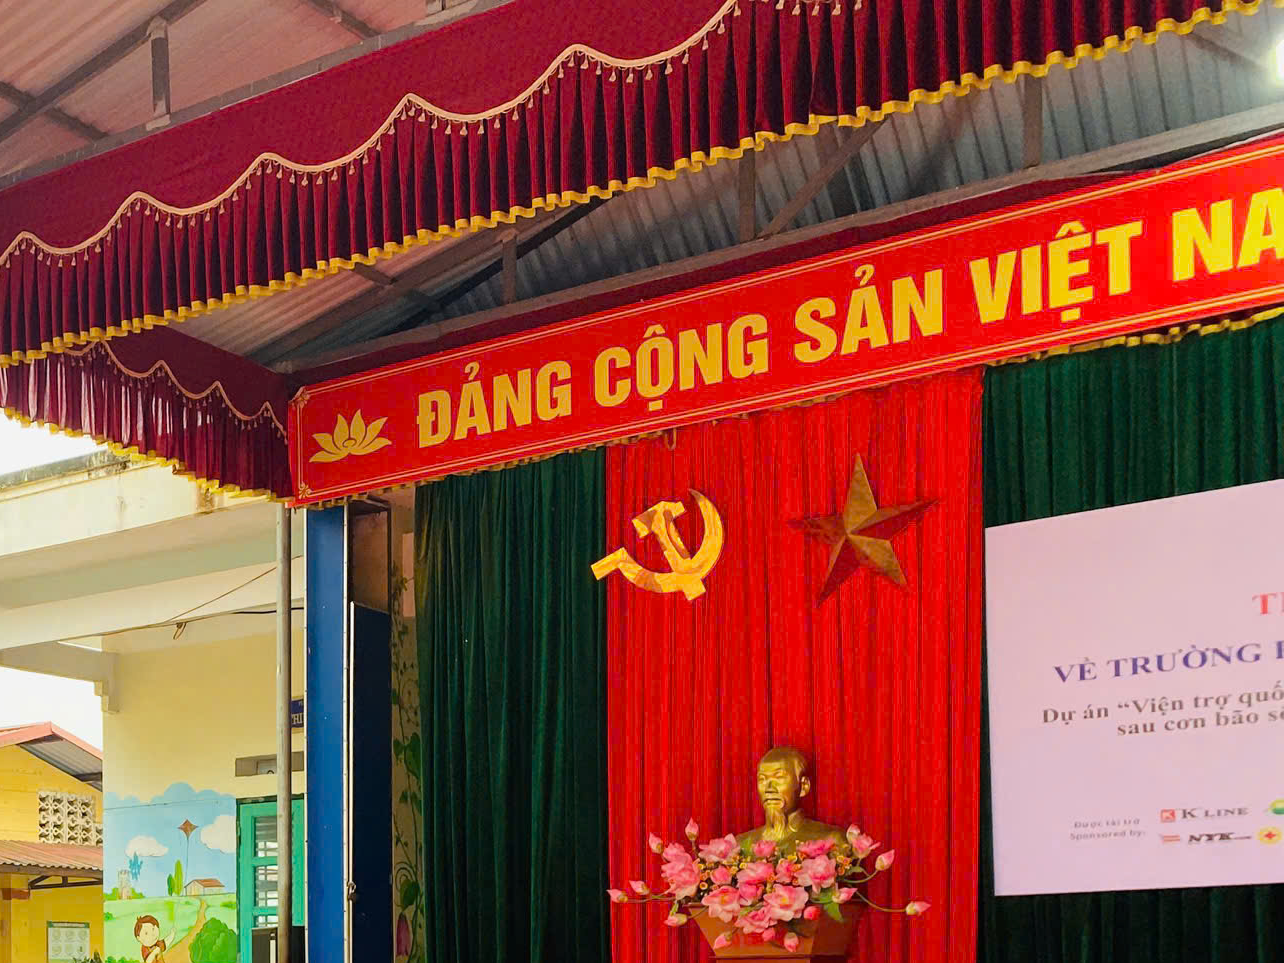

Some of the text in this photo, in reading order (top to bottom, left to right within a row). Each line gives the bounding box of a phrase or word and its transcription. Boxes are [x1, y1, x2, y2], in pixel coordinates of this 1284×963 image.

[416, 361, 572, 448] ĐẢNG
[593, 313, 769, 412] CỘNG
[793, 264, 944, 364] SẢN
[968, 220, 1143, 323] VIỆT
[1107, 643, 1262, 677] TRƯỜNG
[1042, 707, 1077, 726] Dự
[1083, 704, 1109, 720] án
[1193, 694, 1232, 711] trợ
[1117, 721, 1156, 736] sau
[1164, 715, 1206, 732] cơn
[1215, 709, 1259, 727] bão
[1204, 807, 1251, 817] LINE
[1188, 831, 1235, 843] NYK
